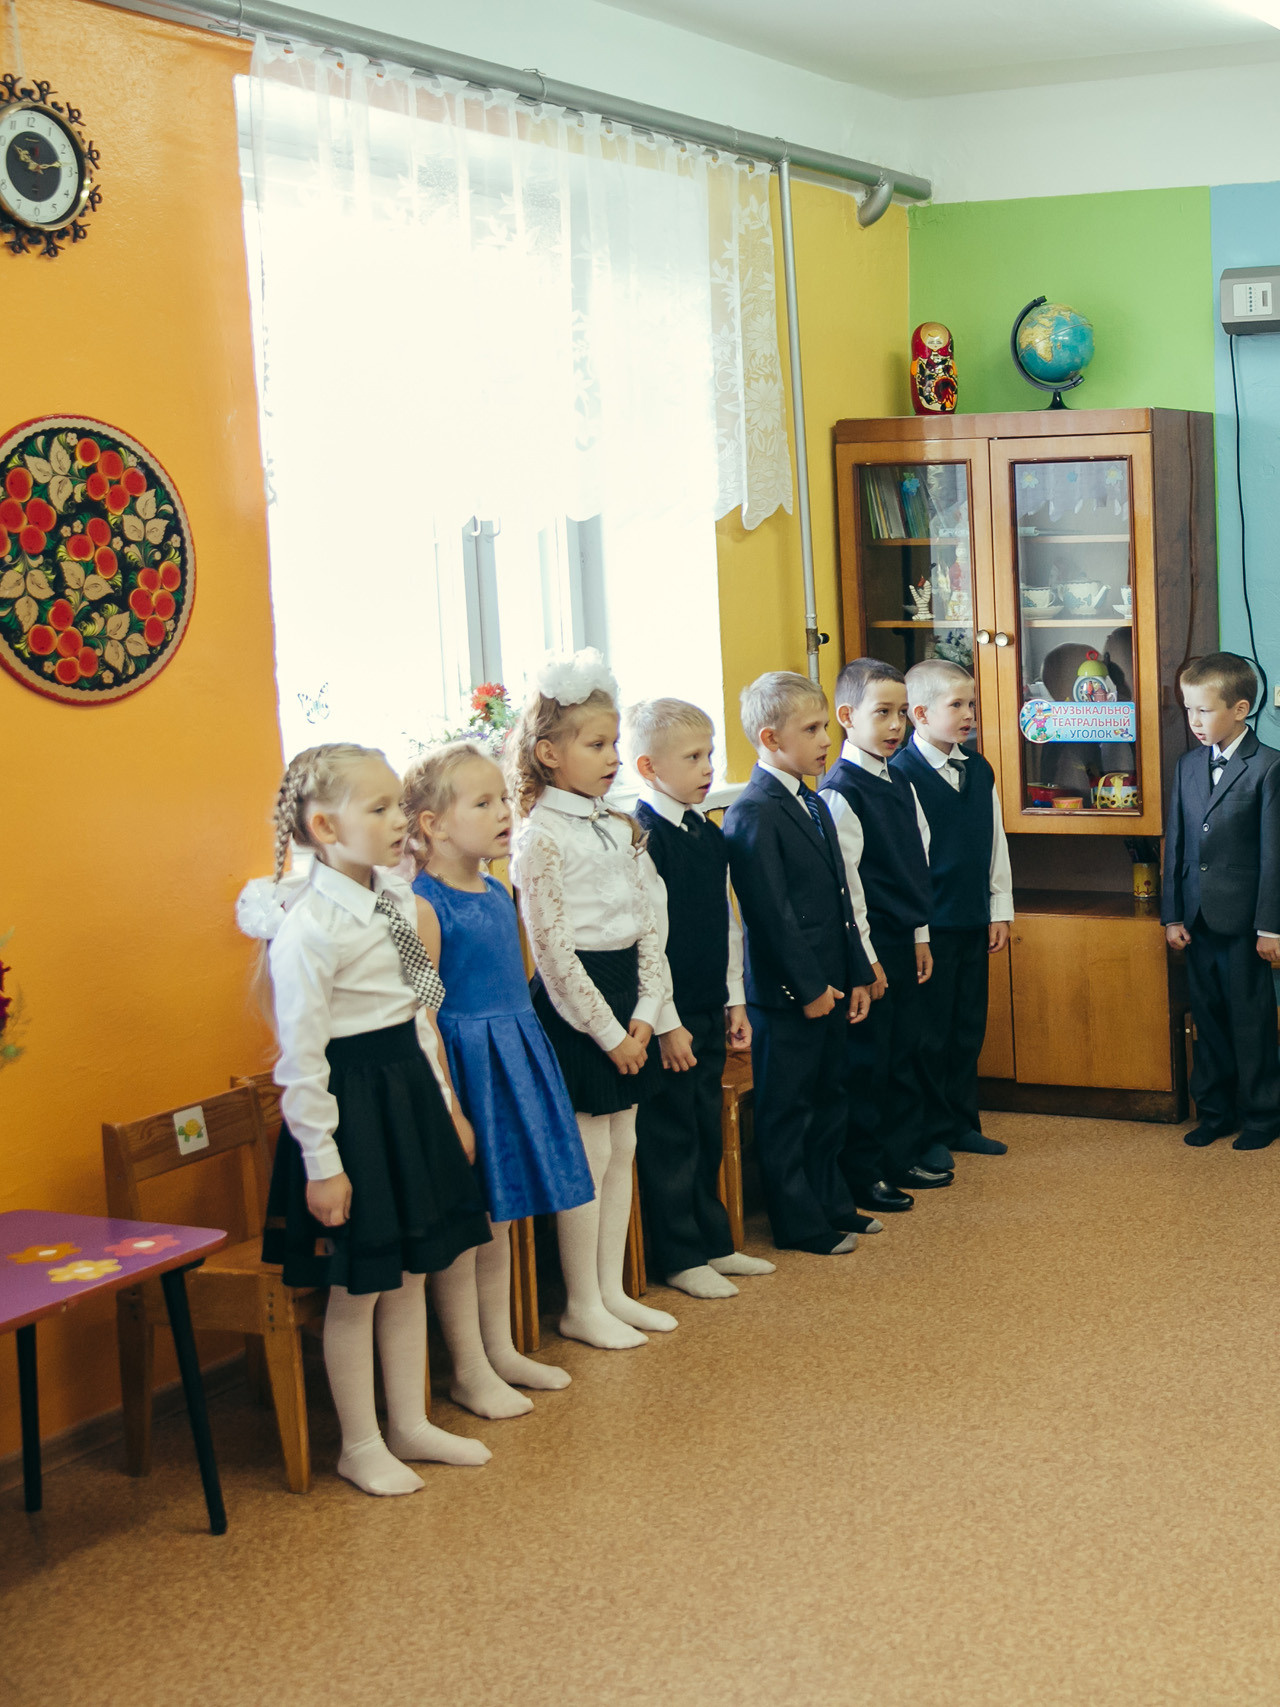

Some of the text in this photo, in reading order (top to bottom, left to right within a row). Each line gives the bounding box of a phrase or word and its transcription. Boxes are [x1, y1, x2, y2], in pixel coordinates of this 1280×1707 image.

[10, 120, 17, 130] 11
[27, 116, 36, 128] 12
[0, 135, 6, 146] 0
[61, 143, 66, 154] 2
[67, 166, 73, 177] 3
[64, 190, 70, 198] 4
[17, 199, 21, 209] 7
[52, 203, 57, 213] 5
[1052, 706, 1134, 715] МУЗЫКАЛЬНО-
[1052, 716, 1130, 727] ТЕАТРАЛЬНЫЙ
[1069, 729, 1113, 738] УГОЛОК
